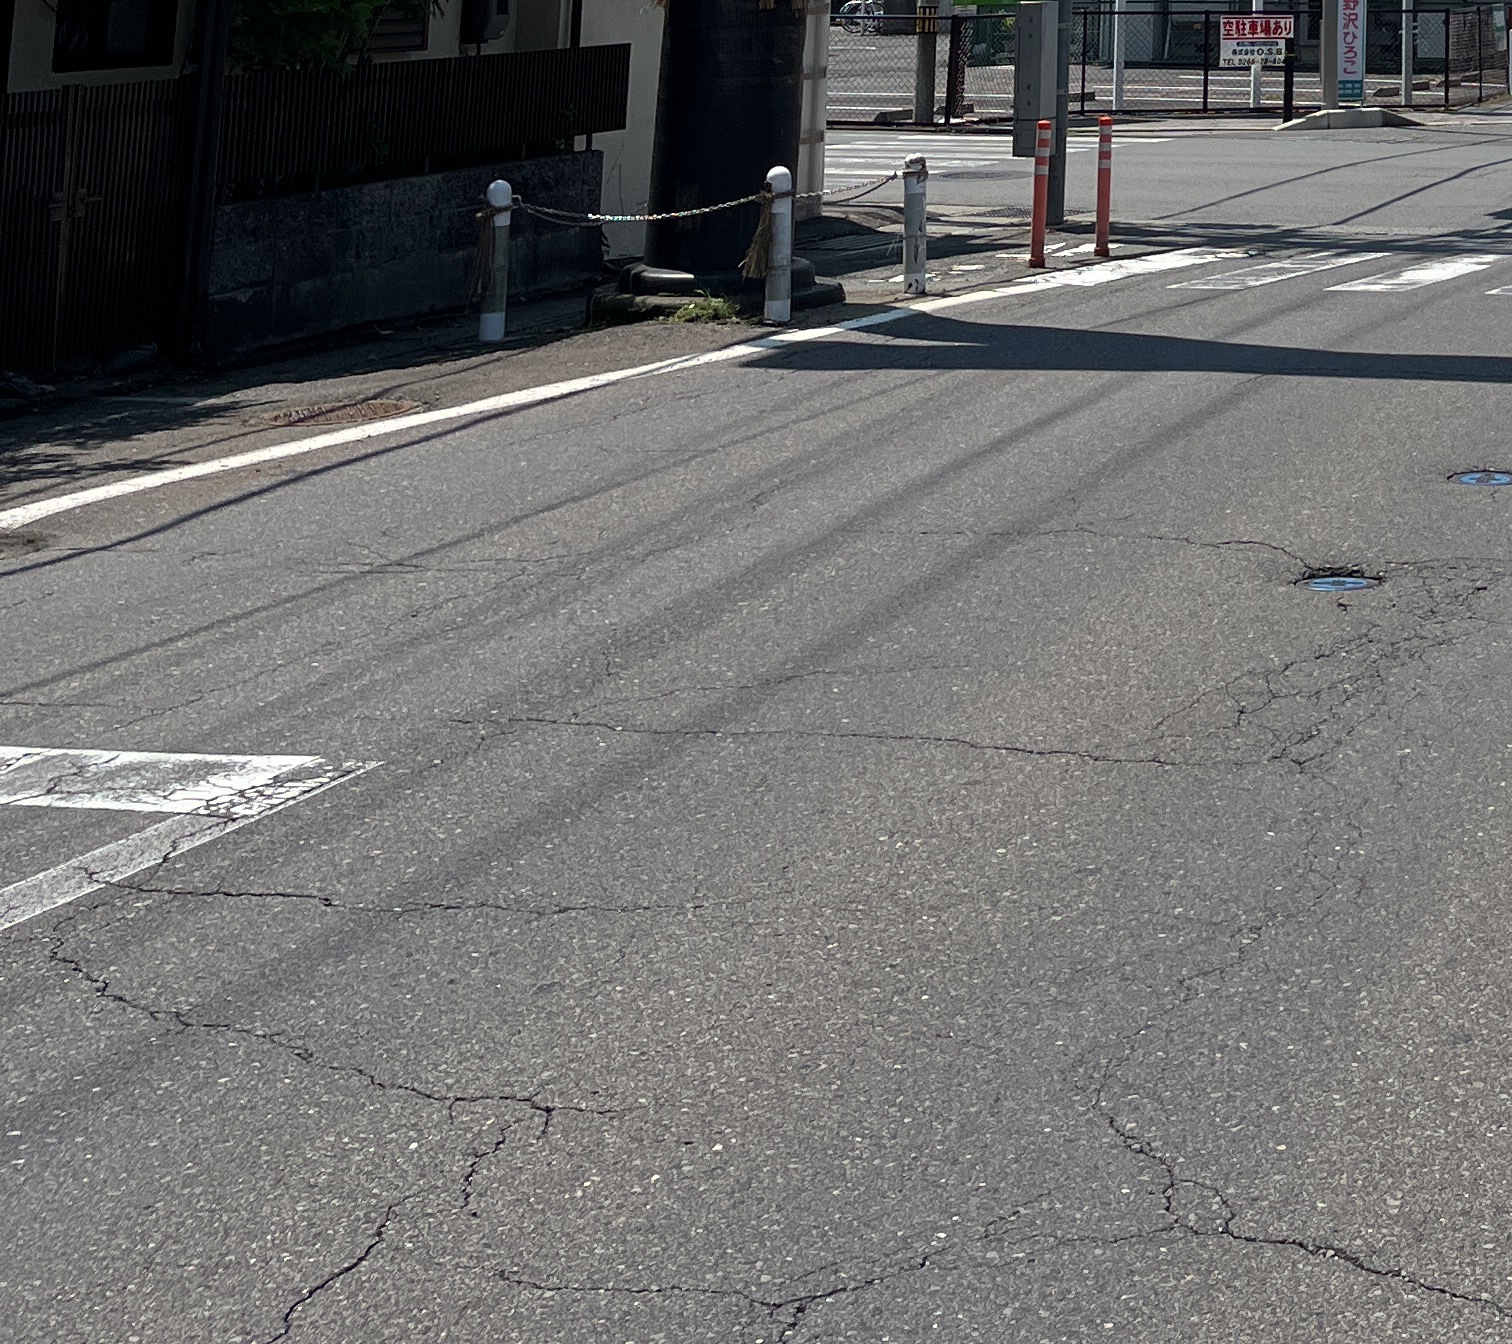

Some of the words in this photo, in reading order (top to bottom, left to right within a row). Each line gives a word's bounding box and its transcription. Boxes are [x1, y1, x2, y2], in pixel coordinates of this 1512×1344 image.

[1222, 19, 1292, 37] 空駐車場あり
[1222, 58, 1236, 66] TEL
